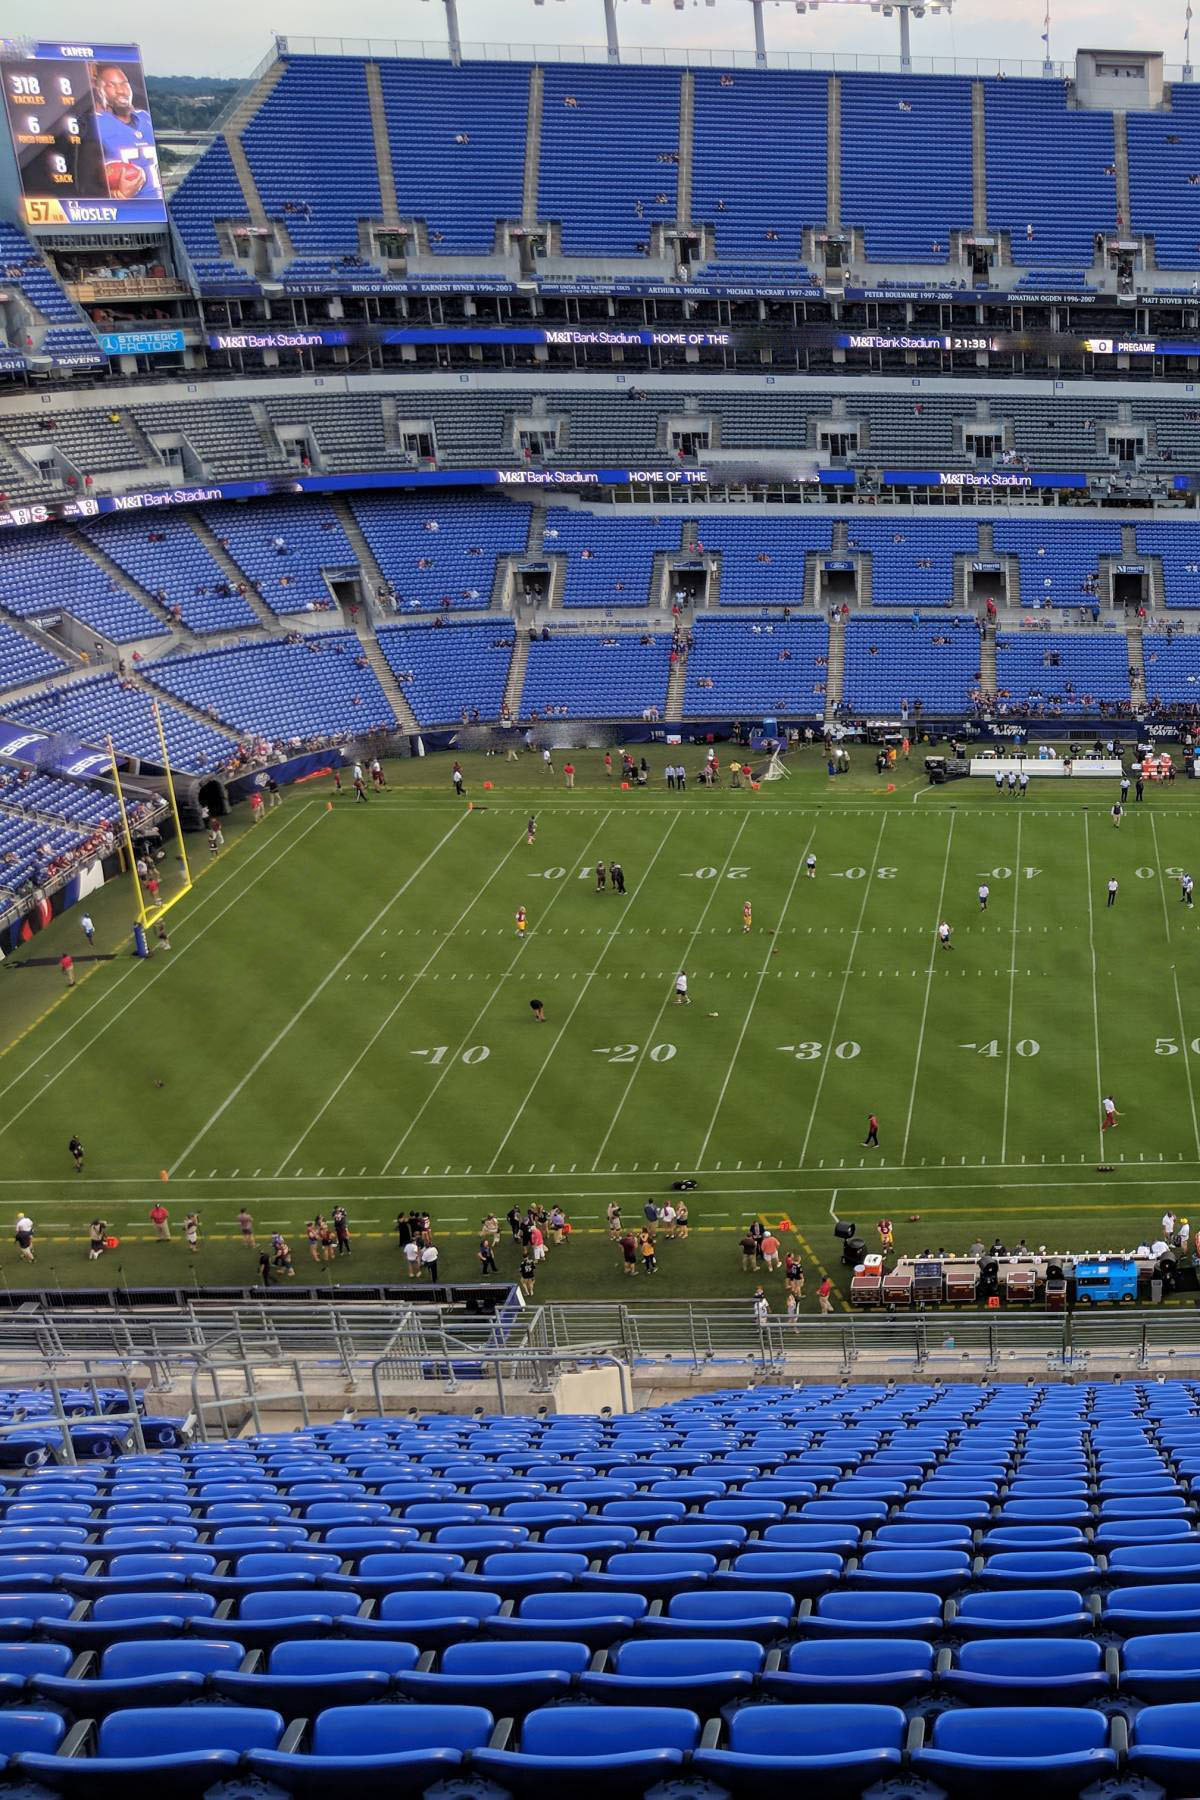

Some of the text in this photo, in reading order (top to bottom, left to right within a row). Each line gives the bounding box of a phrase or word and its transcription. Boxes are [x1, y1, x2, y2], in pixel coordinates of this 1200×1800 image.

[61, 47, 94, 57] CAREER
[11, 76, 72, 95] 318 8
[12, 95, 75, 105] TACKLES INT
[28, 116, 79, 134] 6 6
[70, 136, 81, 145] FR
[55, 155, 67, 173] 8
[53, 174, 74, 183] SACK
[30, 202, 50, 221] 57
[70, 208, 118, 221] MOSLEY
[684, 287, 710, 295] MODELL
[756, 288, 786, 296] McCRARY
[787, 289, 821, 297] 1997-2002
[885, 291, 919, 299] BOULWARE
[1007, 294, 1096, 303] JONATHAN OGDEN 1996-2007
[1159, 297, 1183, 305] STOVER
[118, 333, 178, 343] STRATEGIC
[218, 334, 322, 348] M&T Bank Stadium
[545, 332, 641, 344] M&T Bank Stadium
[653, 334, 729, 345] HOME OF THE
[850, 336, 940, 348] M&T Bank Stadium
[954, 339, 987, 349] 21:38
[119, 341, 179, 352] FACTORY
[1099, 342, 1107, 351] 0
[1118, 343, 1155, 352] PREGAME
[57, 356, 101, 365] RAVENS
[499, 471, 599, 483] M&T Bank Stadium
[629, 471, 708, 482] HOME OF THE
[939, 473, 1032, 486] M&T Bank Stadium
[113, 488, 222, 510] M&T Bank Stadium
[0, 733, 49, 756] GEICO
[543, 867, 593, 879] 10
[695, 867, 751, 879] 20
[845, 867, 899, 879] 30
[991, 866, 1043, 879] 40
[1135, 866, 1185, 879] 50
[424, 1045, 490, 1064] 10
[607, 1043, 677, 1063] 20
[795, 1041, 861, 1060] 30
[977, 1039, 1040, 1058] 40
